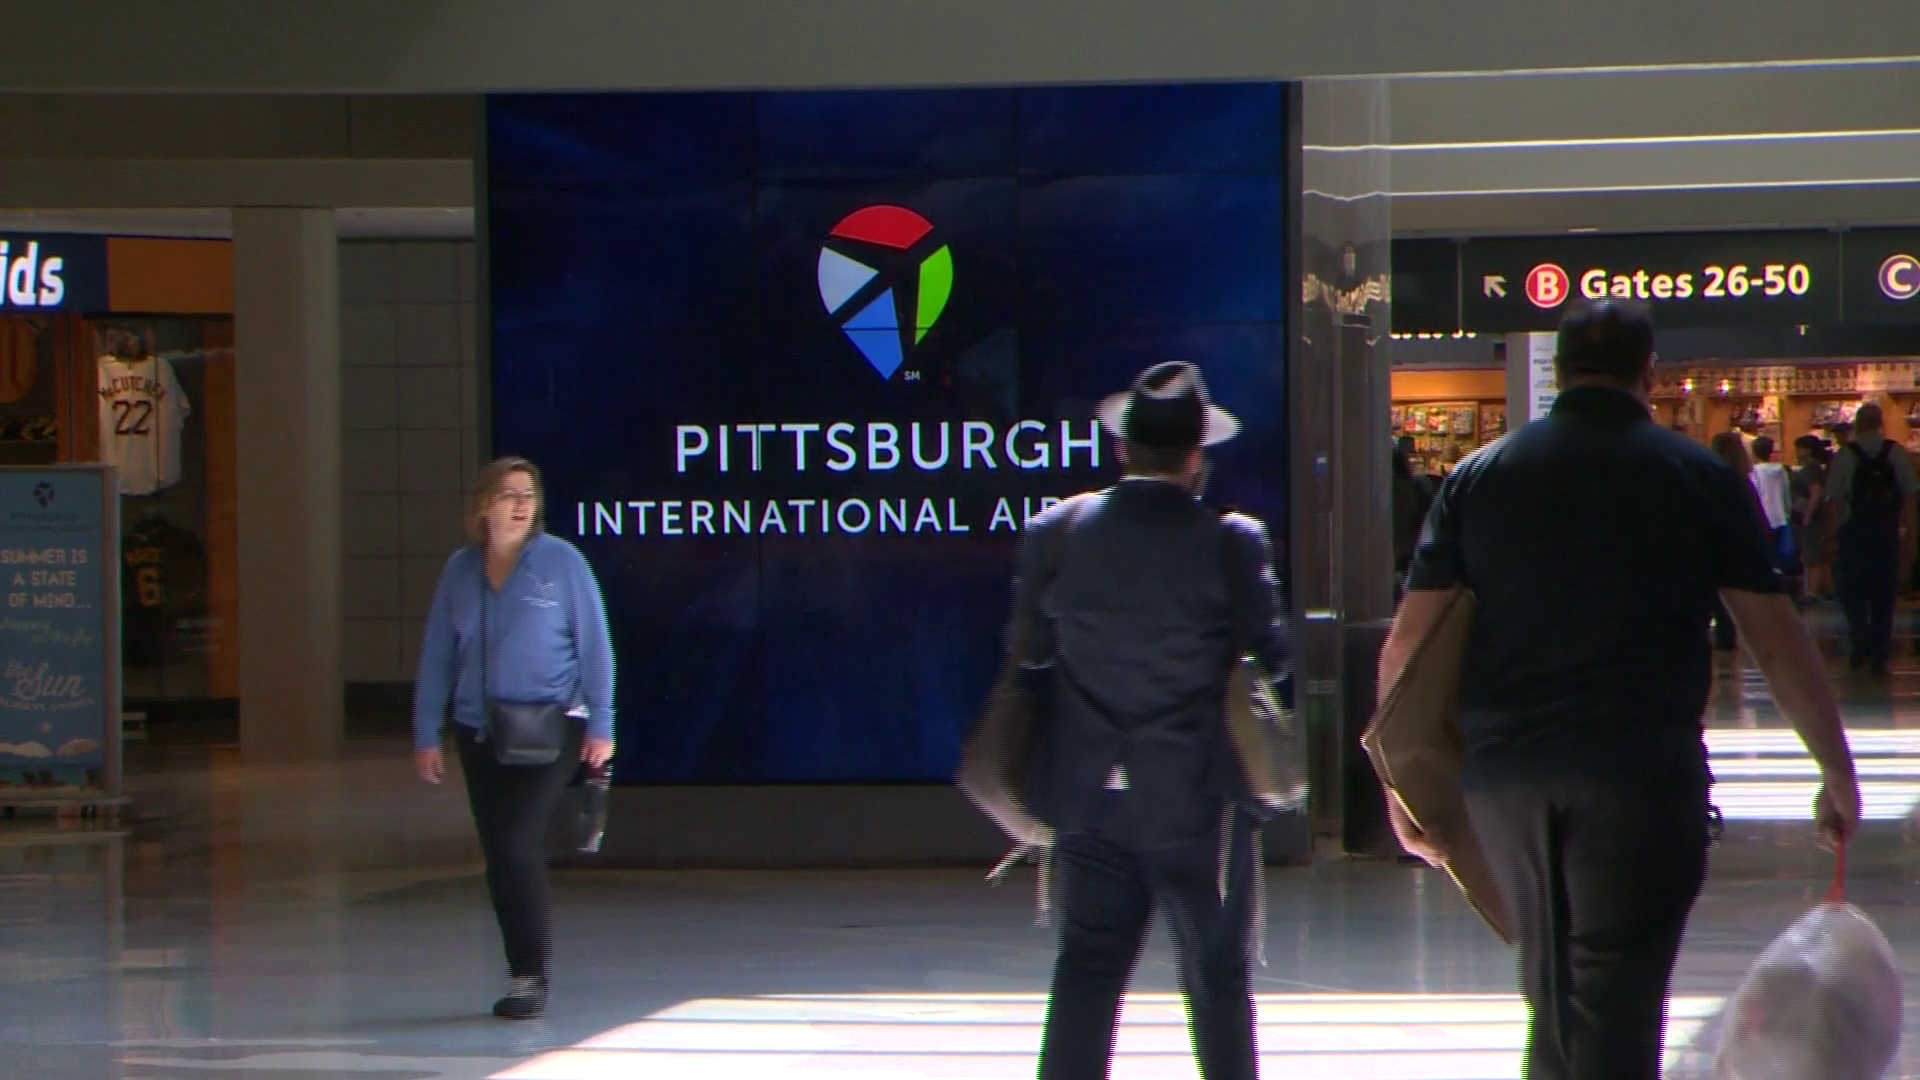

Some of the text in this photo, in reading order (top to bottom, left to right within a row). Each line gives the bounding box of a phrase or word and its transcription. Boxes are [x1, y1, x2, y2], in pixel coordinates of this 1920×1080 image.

[1537, 264, 1810, 301] B Gates 26-50
[1886, 261, 1912, 292] C
[904, 370, 920, 381] SM
[112, 399, 153, 435] 22
[676, 420, 1100, 472] PITTSBURGH
[577, 498, 970, 535] INTERNATIONAL
[1, 548, 89, 564] SUMMER IS
[13, 570, 77, 586] A STATE
[9, 592, 28, 608] OF
[10, 662, 86, 701] Sun
